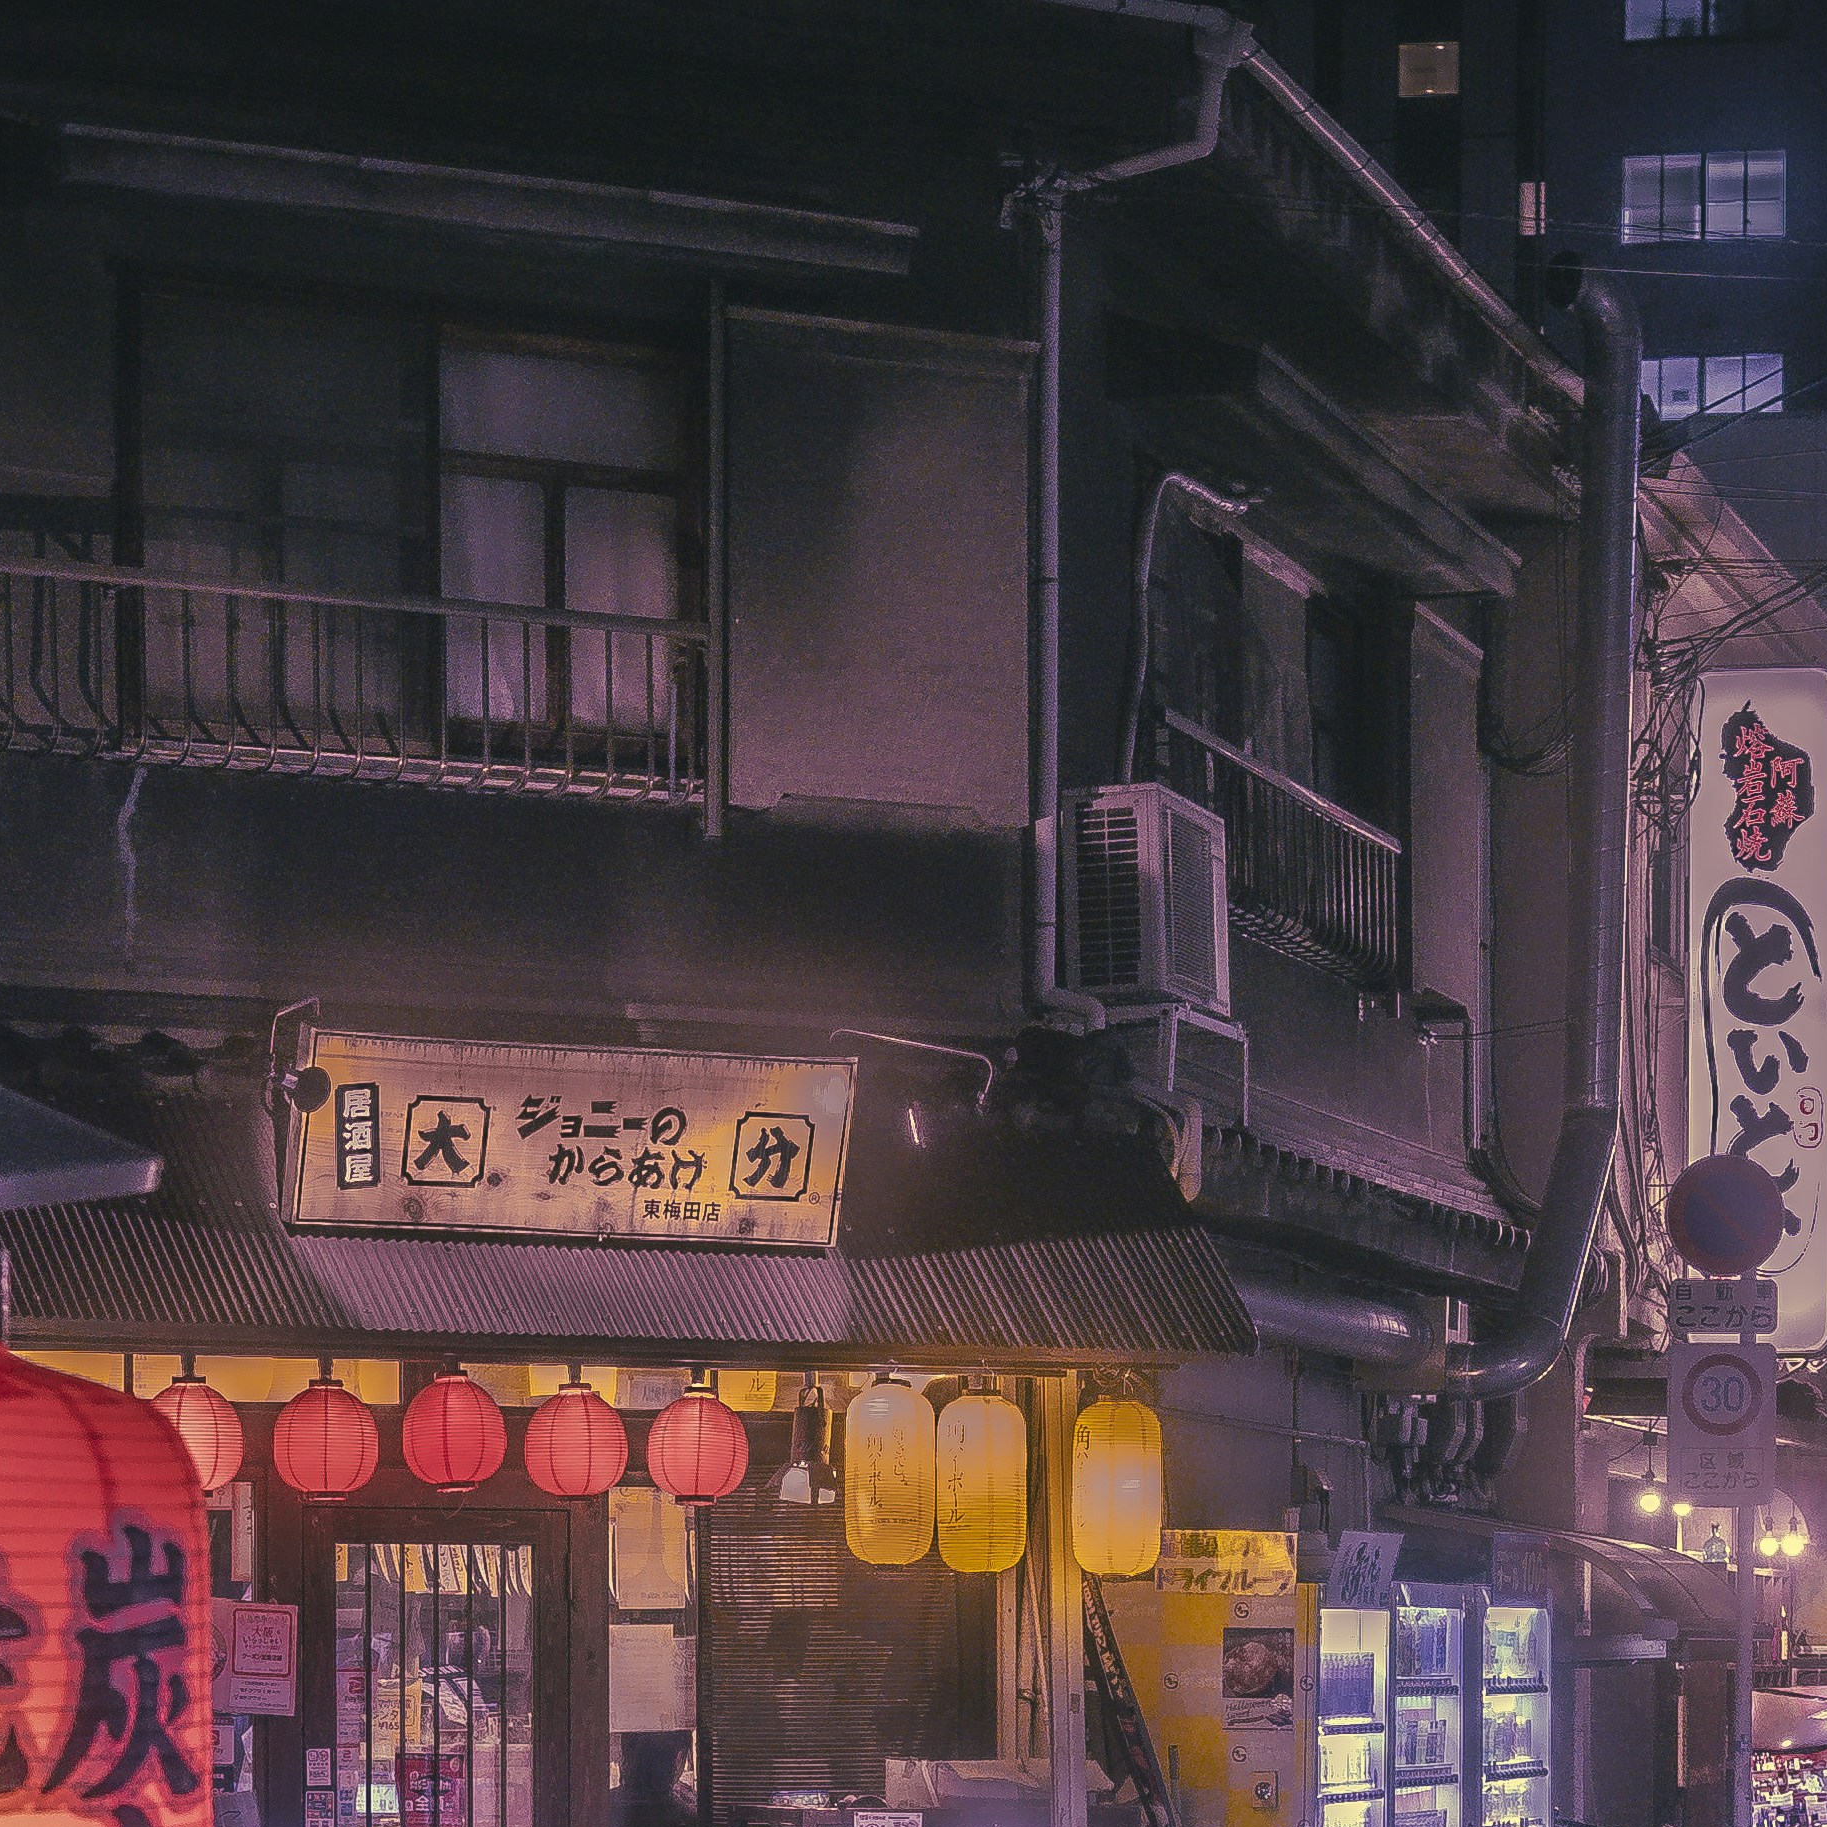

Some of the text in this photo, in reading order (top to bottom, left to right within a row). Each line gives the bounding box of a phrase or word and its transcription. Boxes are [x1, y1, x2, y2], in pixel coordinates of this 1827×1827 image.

[343, 1090, 373, 1183] 居酒屋
[414, 1111, 471, 1175] 大
[515, 1094, 688, 1146] ジョニーの
[548, 1144, 709, 1190] からあげ
[742, 1126, 800, 1188] 分
[642, 1199, 722, 1222] 東梅田店
[1675, 1304, 1773, 1328] ここから
[1701, 1375, 1744, 1412] 30
[1684, 1471, 1761, 1489] ここから
